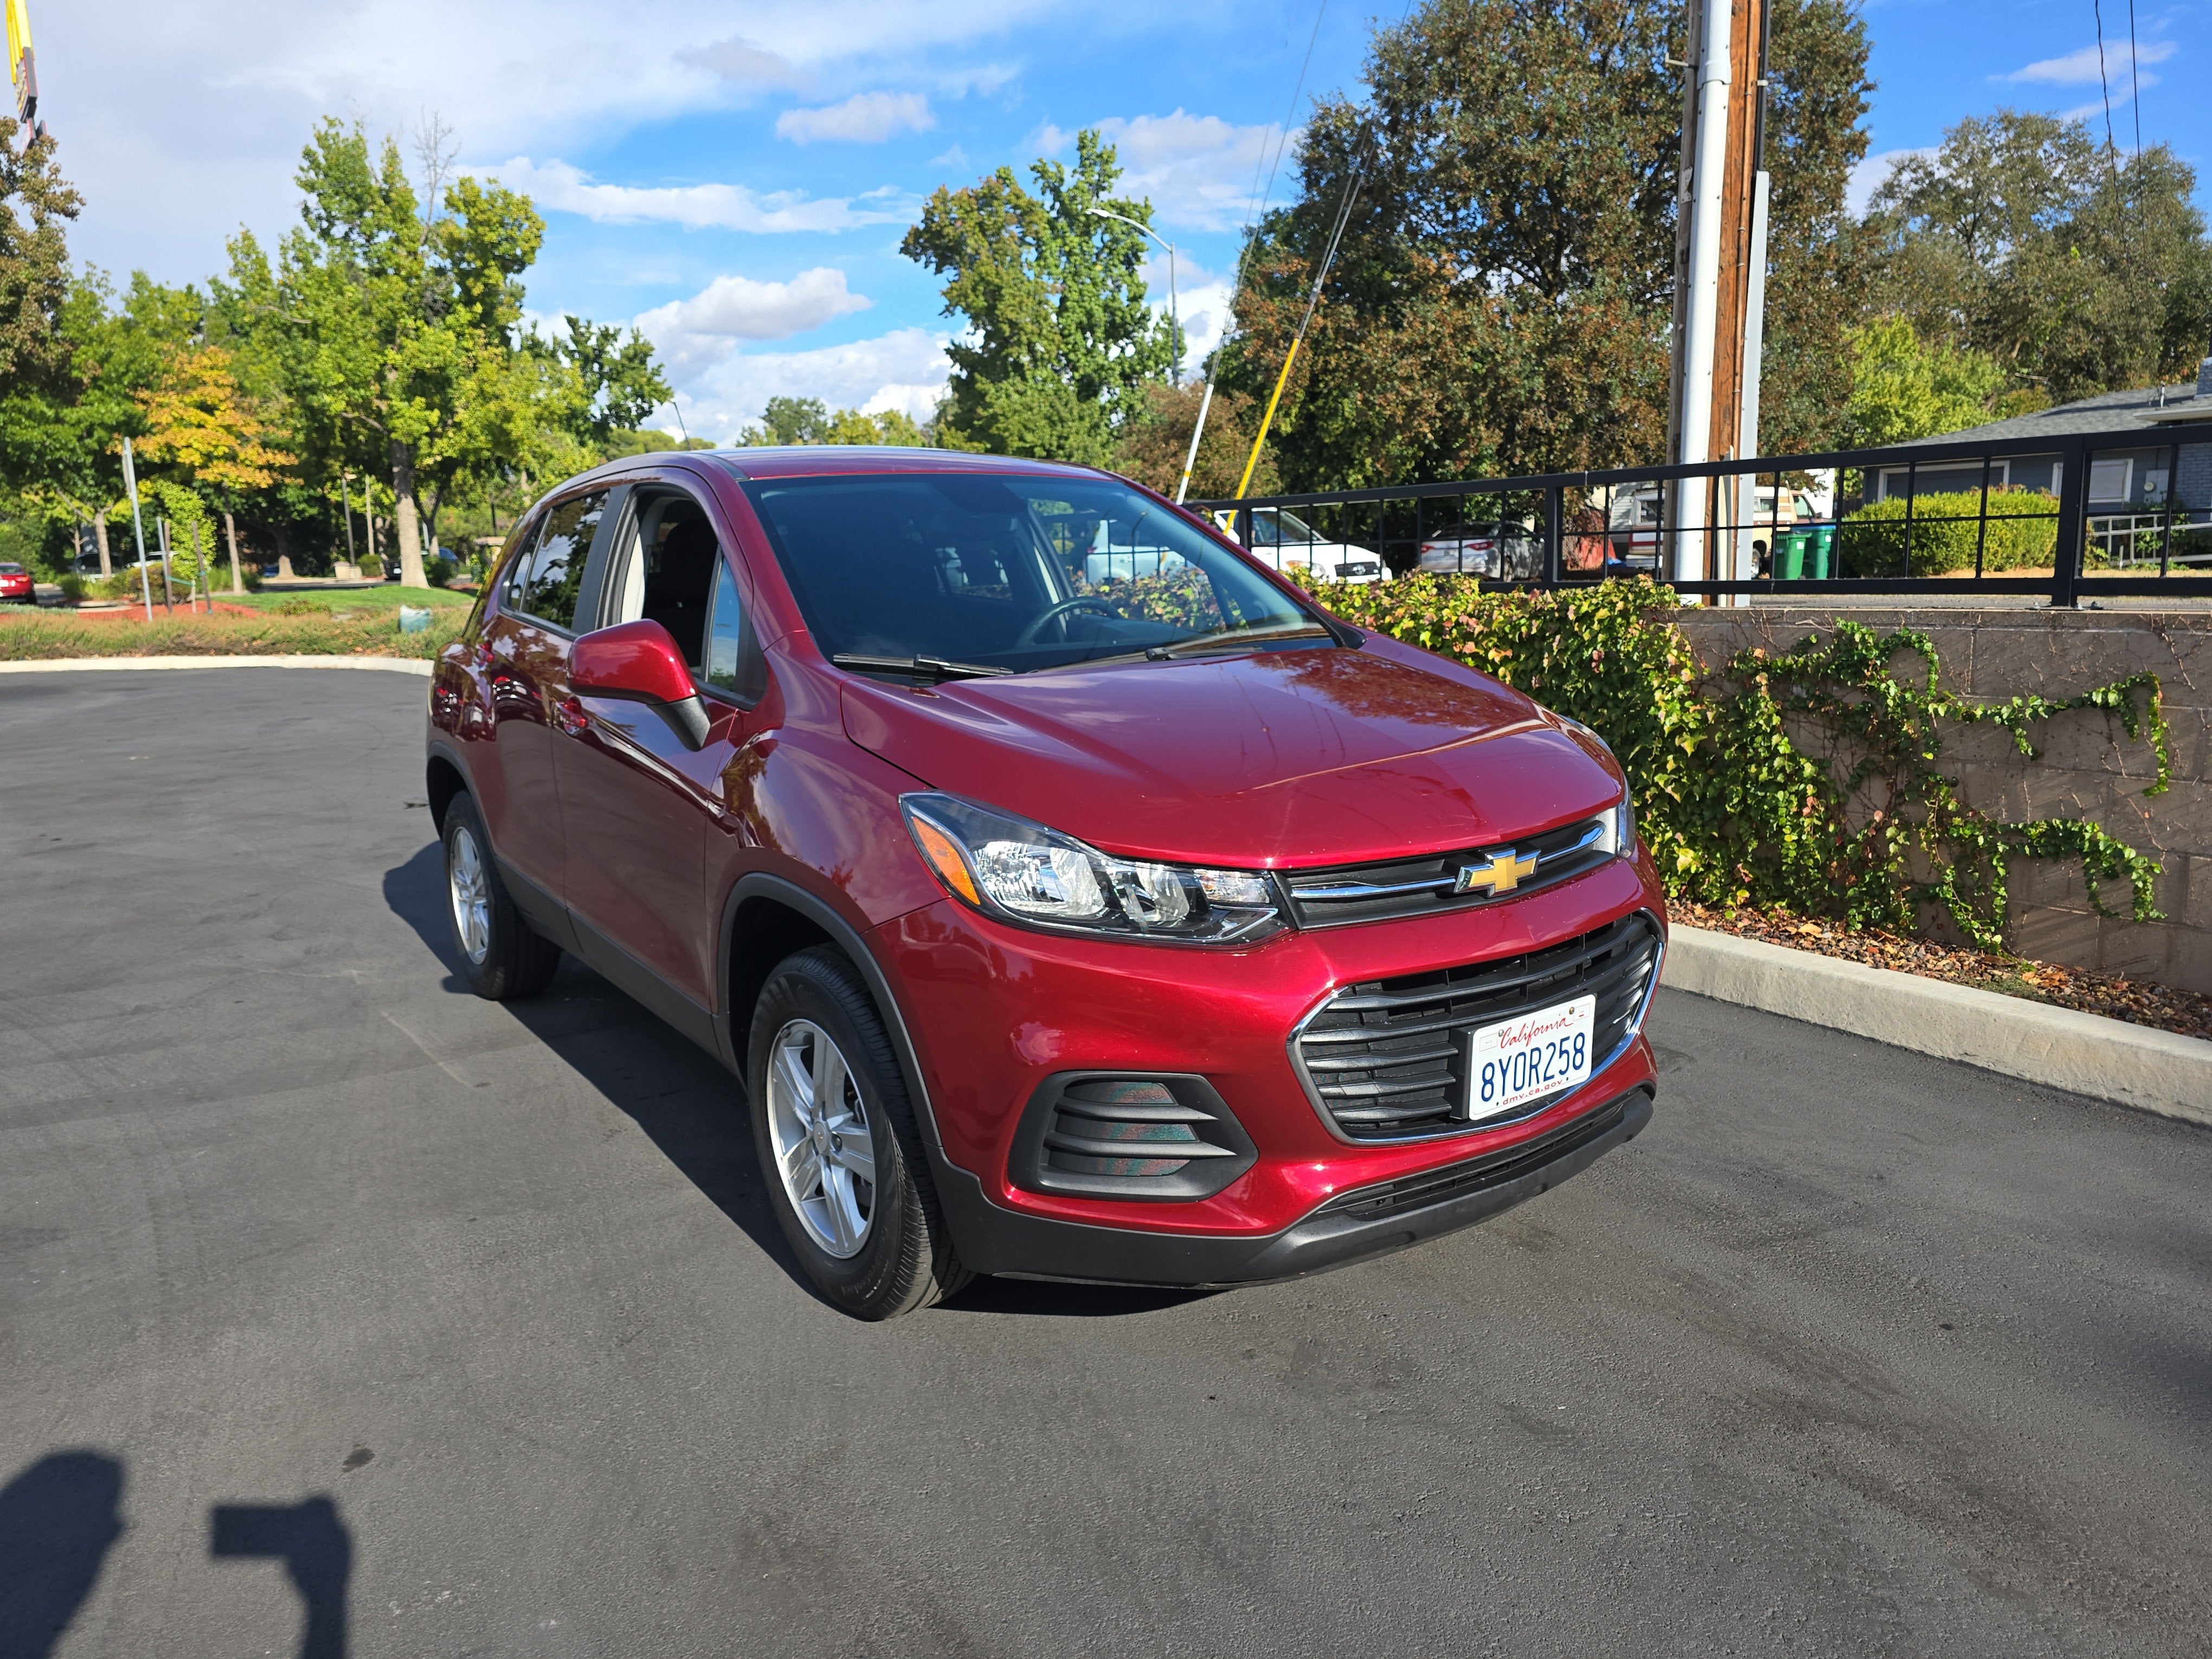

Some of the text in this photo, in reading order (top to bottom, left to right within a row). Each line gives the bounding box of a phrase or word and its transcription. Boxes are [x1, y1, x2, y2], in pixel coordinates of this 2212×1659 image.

[1500, 1013, 1573, 1049] California
[1481, 1032, 1585, 1102] 8YOR258
[1503, 1079, 1562, 1105] dmv.ca.gov
